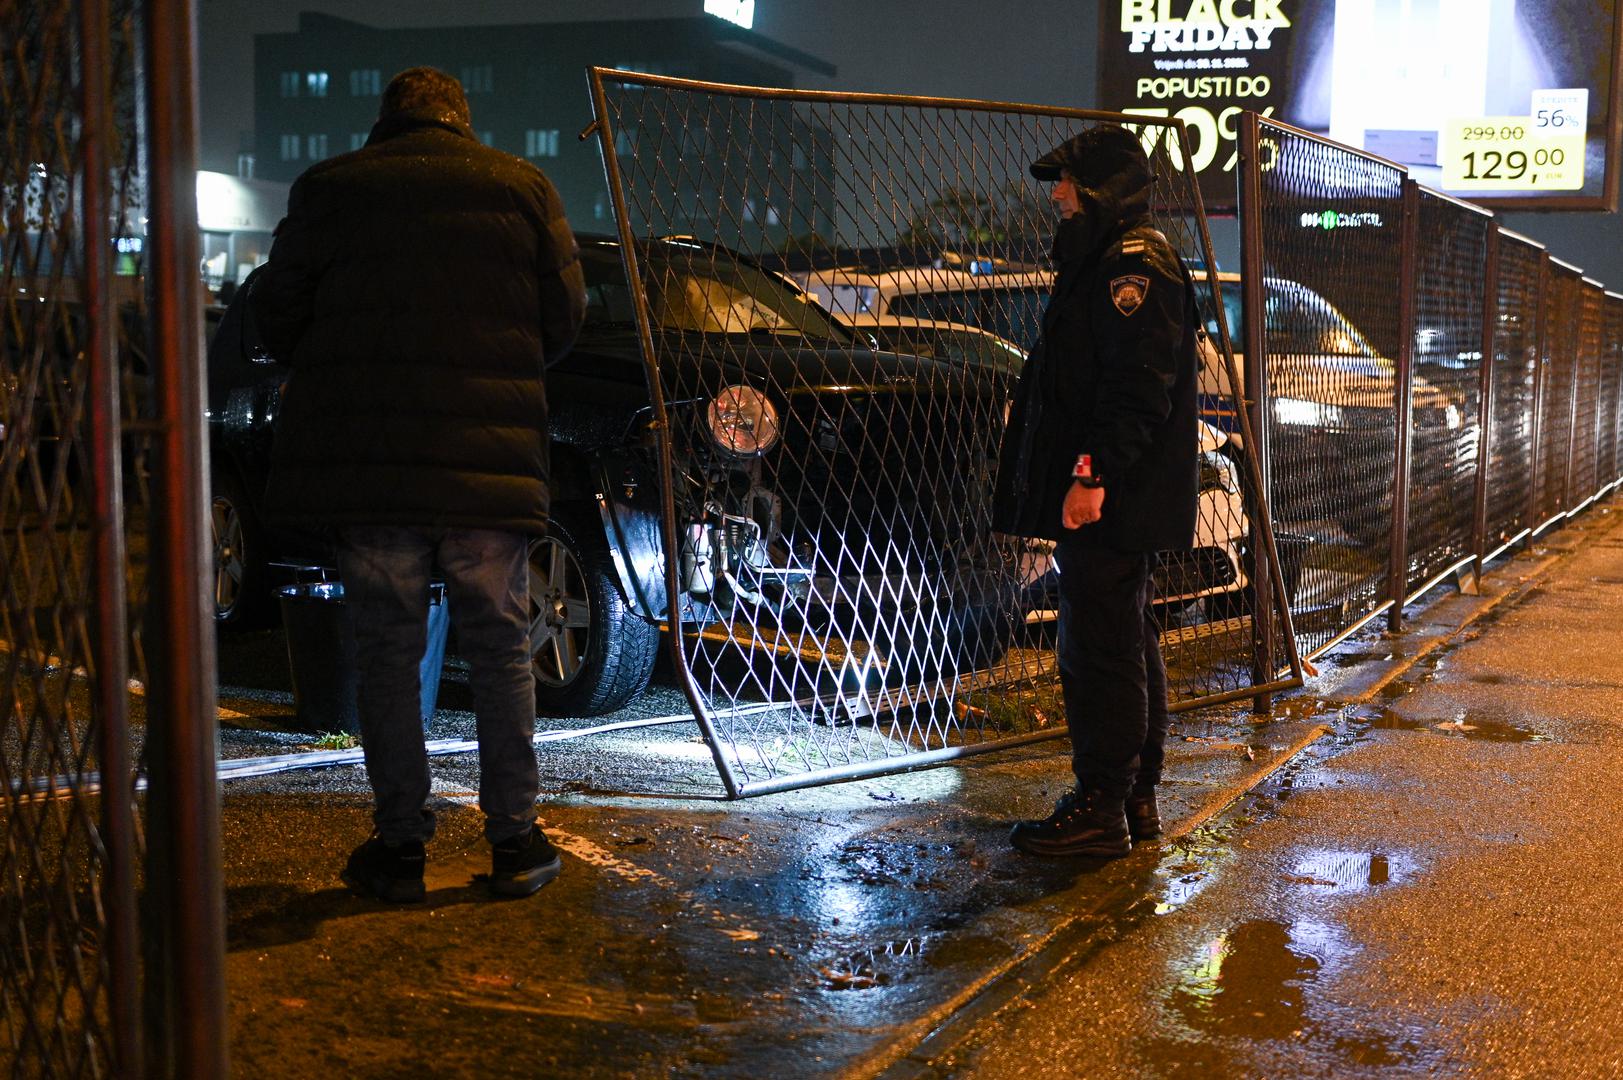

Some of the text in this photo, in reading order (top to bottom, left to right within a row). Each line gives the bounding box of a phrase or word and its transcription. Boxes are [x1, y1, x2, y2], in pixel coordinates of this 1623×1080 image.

[1121, 0, 1291, 32] BLACK
[1129, 20, 1280, 53] FRIDAY
[1137, 75, 1270, 98] POPUSTI DO
